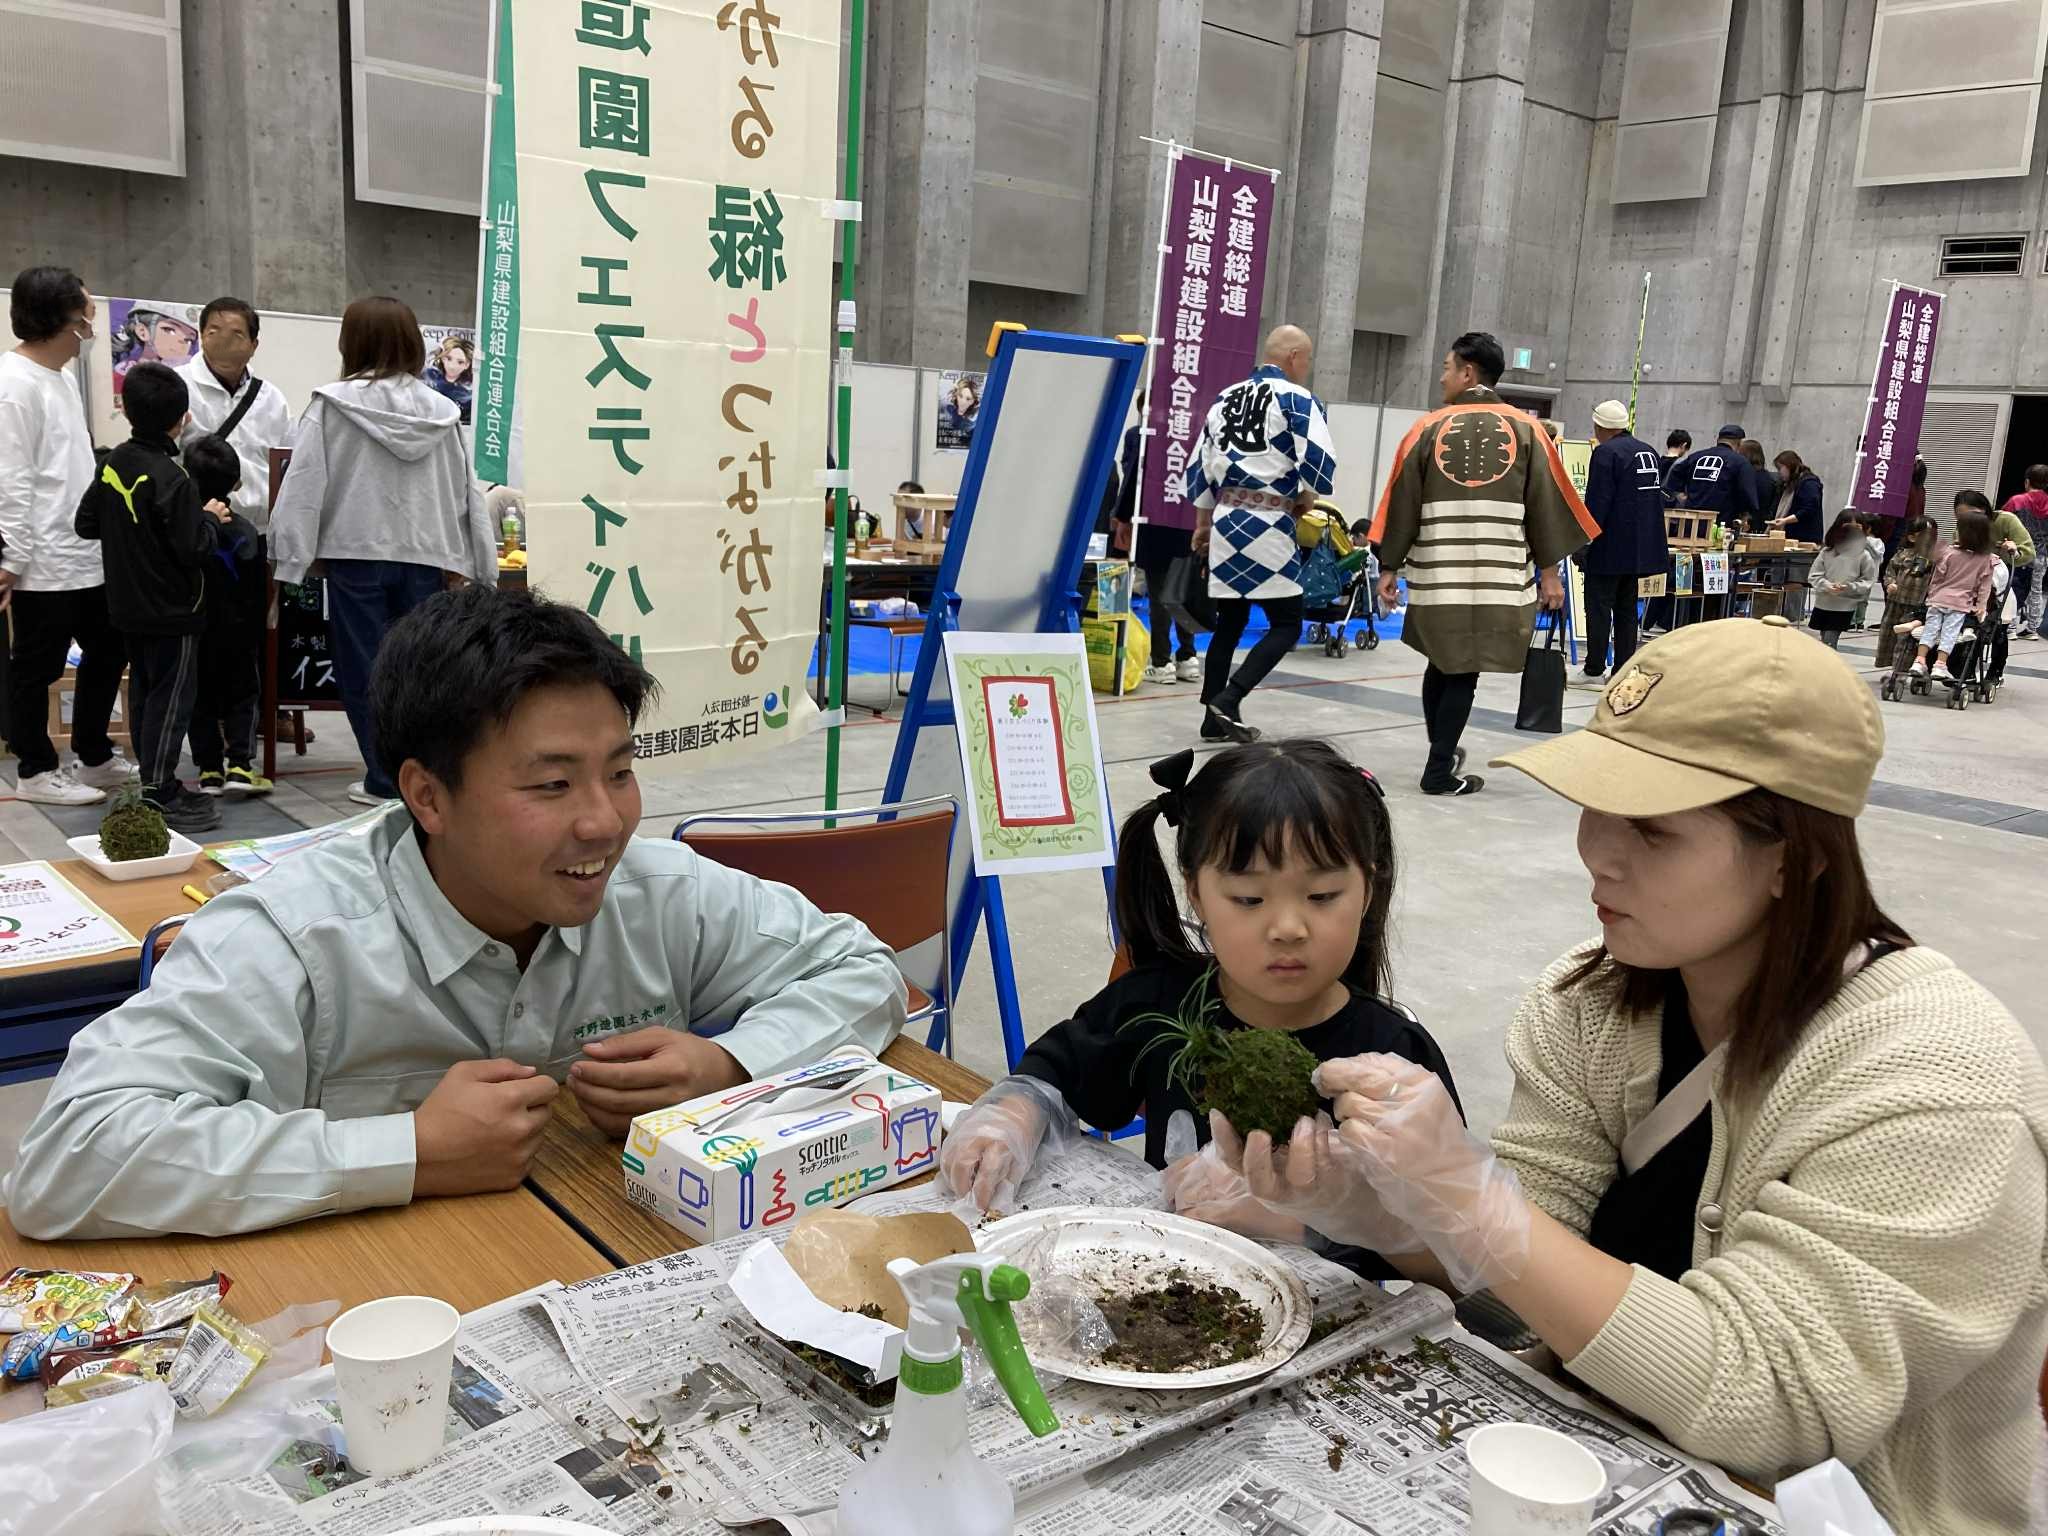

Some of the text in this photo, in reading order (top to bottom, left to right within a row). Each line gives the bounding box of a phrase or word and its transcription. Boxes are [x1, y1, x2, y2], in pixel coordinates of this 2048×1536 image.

[1220, 184, 1259, 317] 全建総連
[485, 200, 516, 458] 山梨県建設組合連合会
[1164, 175, 1219, 505] 山梨県建設組合連合会
[1910, 303, 1934, 384] 全建総連
[1868, 299, 1916, 500] 山梨県建設組合連合会
[291, 655, 336, 691] イス
[799, 1153, 842, 1176] キッチンタオル
